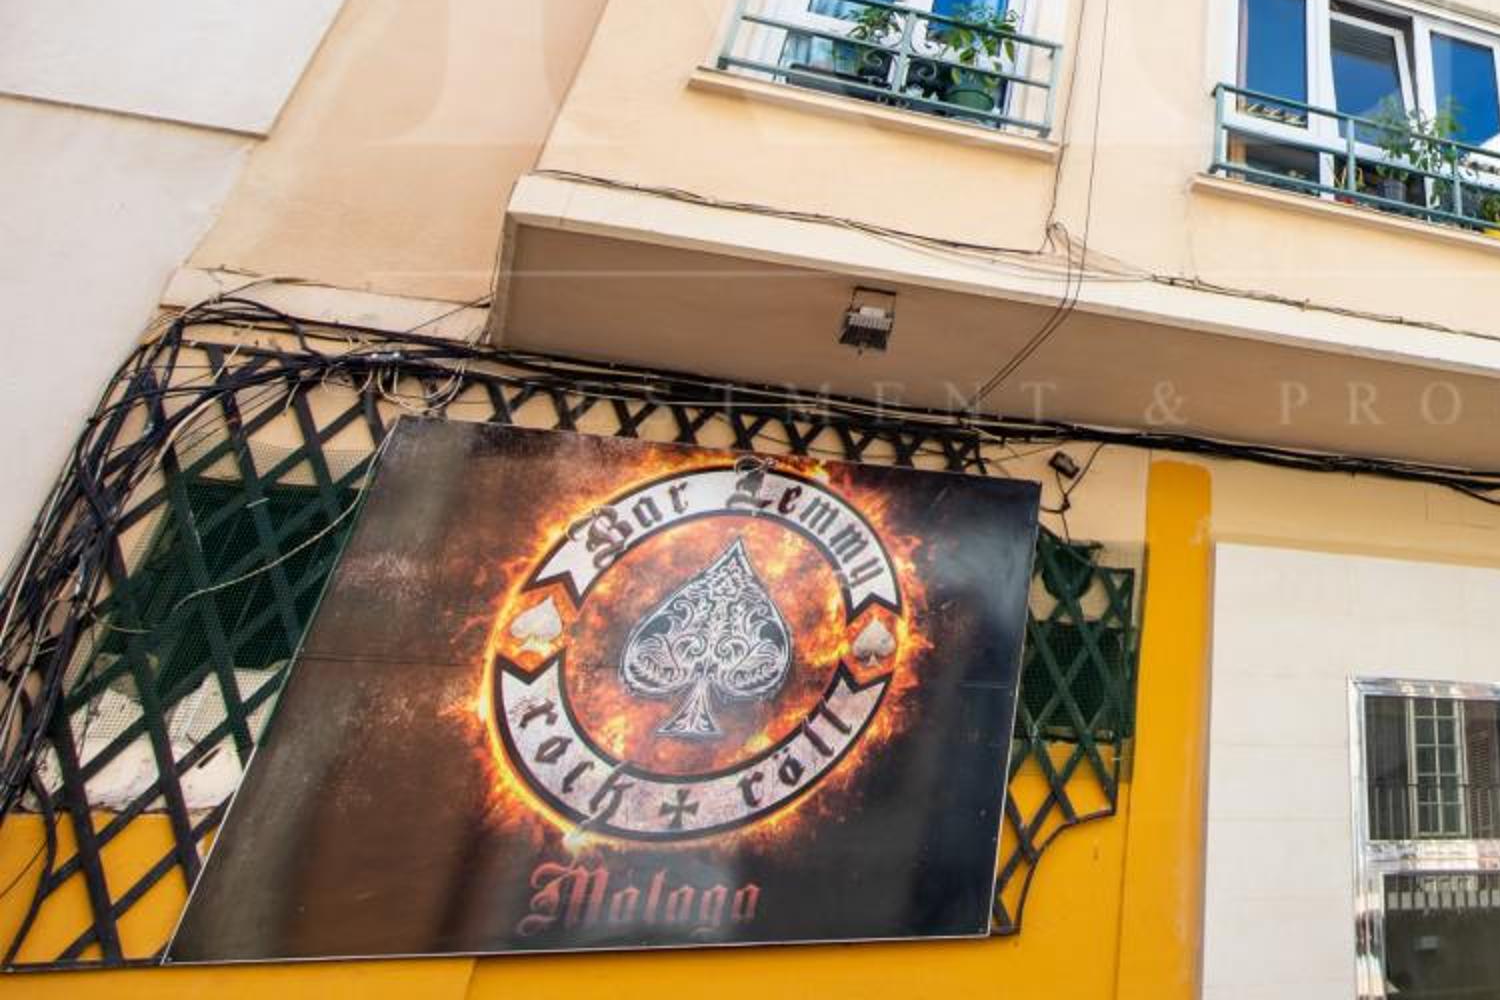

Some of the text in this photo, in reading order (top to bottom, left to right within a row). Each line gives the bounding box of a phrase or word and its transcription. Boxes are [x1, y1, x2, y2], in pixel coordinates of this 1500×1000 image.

[566, 455, 884, 588] Bar Lemmy
[518, 698, 634, 832] rock
